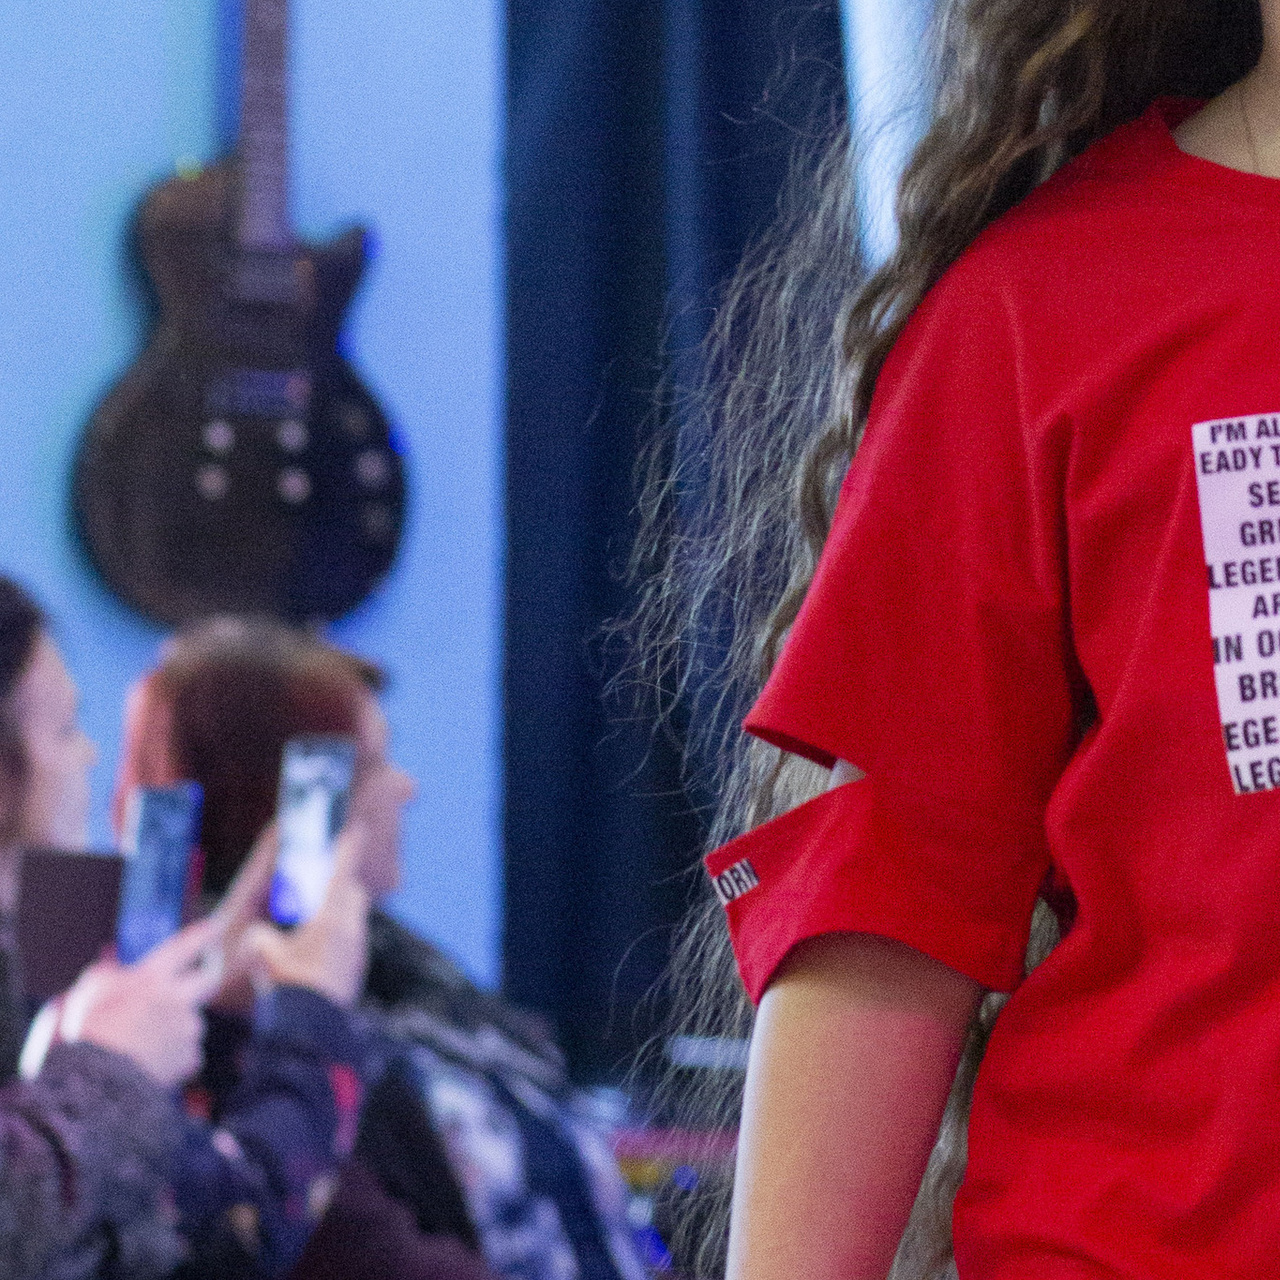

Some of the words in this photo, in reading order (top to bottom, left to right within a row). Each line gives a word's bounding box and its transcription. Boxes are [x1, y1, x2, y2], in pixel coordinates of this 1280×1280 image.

[1210, 421, 1247, 444] I'M
[1200, 445, 1263, 474] EADY
[1213, 634, 1243, 664] IN
[1223, 716, 1279, 751] EGE
